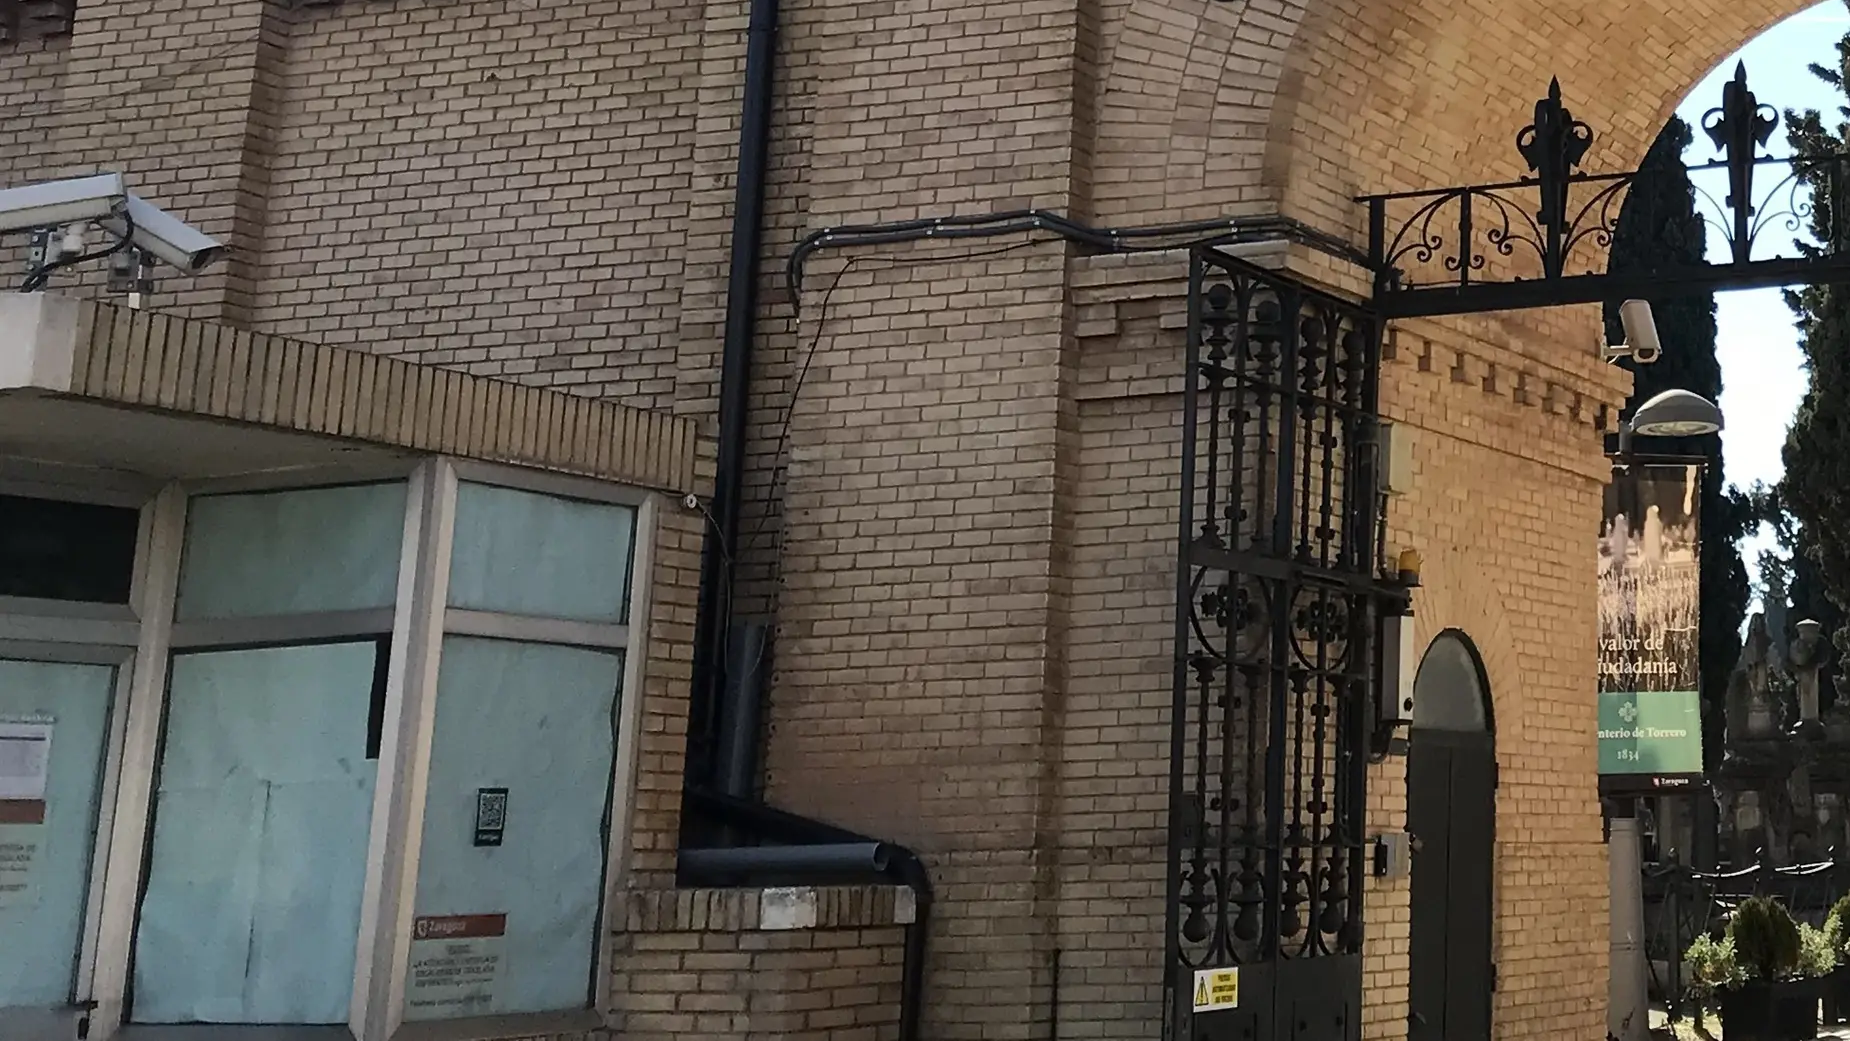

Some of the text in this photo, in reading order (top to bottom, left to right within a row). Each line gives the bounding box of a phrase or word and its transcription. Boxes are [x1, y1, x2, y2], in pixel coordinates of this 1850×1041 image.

[1599, 634, 1664, 651] valor de
[1632, 726, 1645, 738] de
[1646, 727, 1687, 738] Torrero
[1616, 748, 1639, 762] 1834
